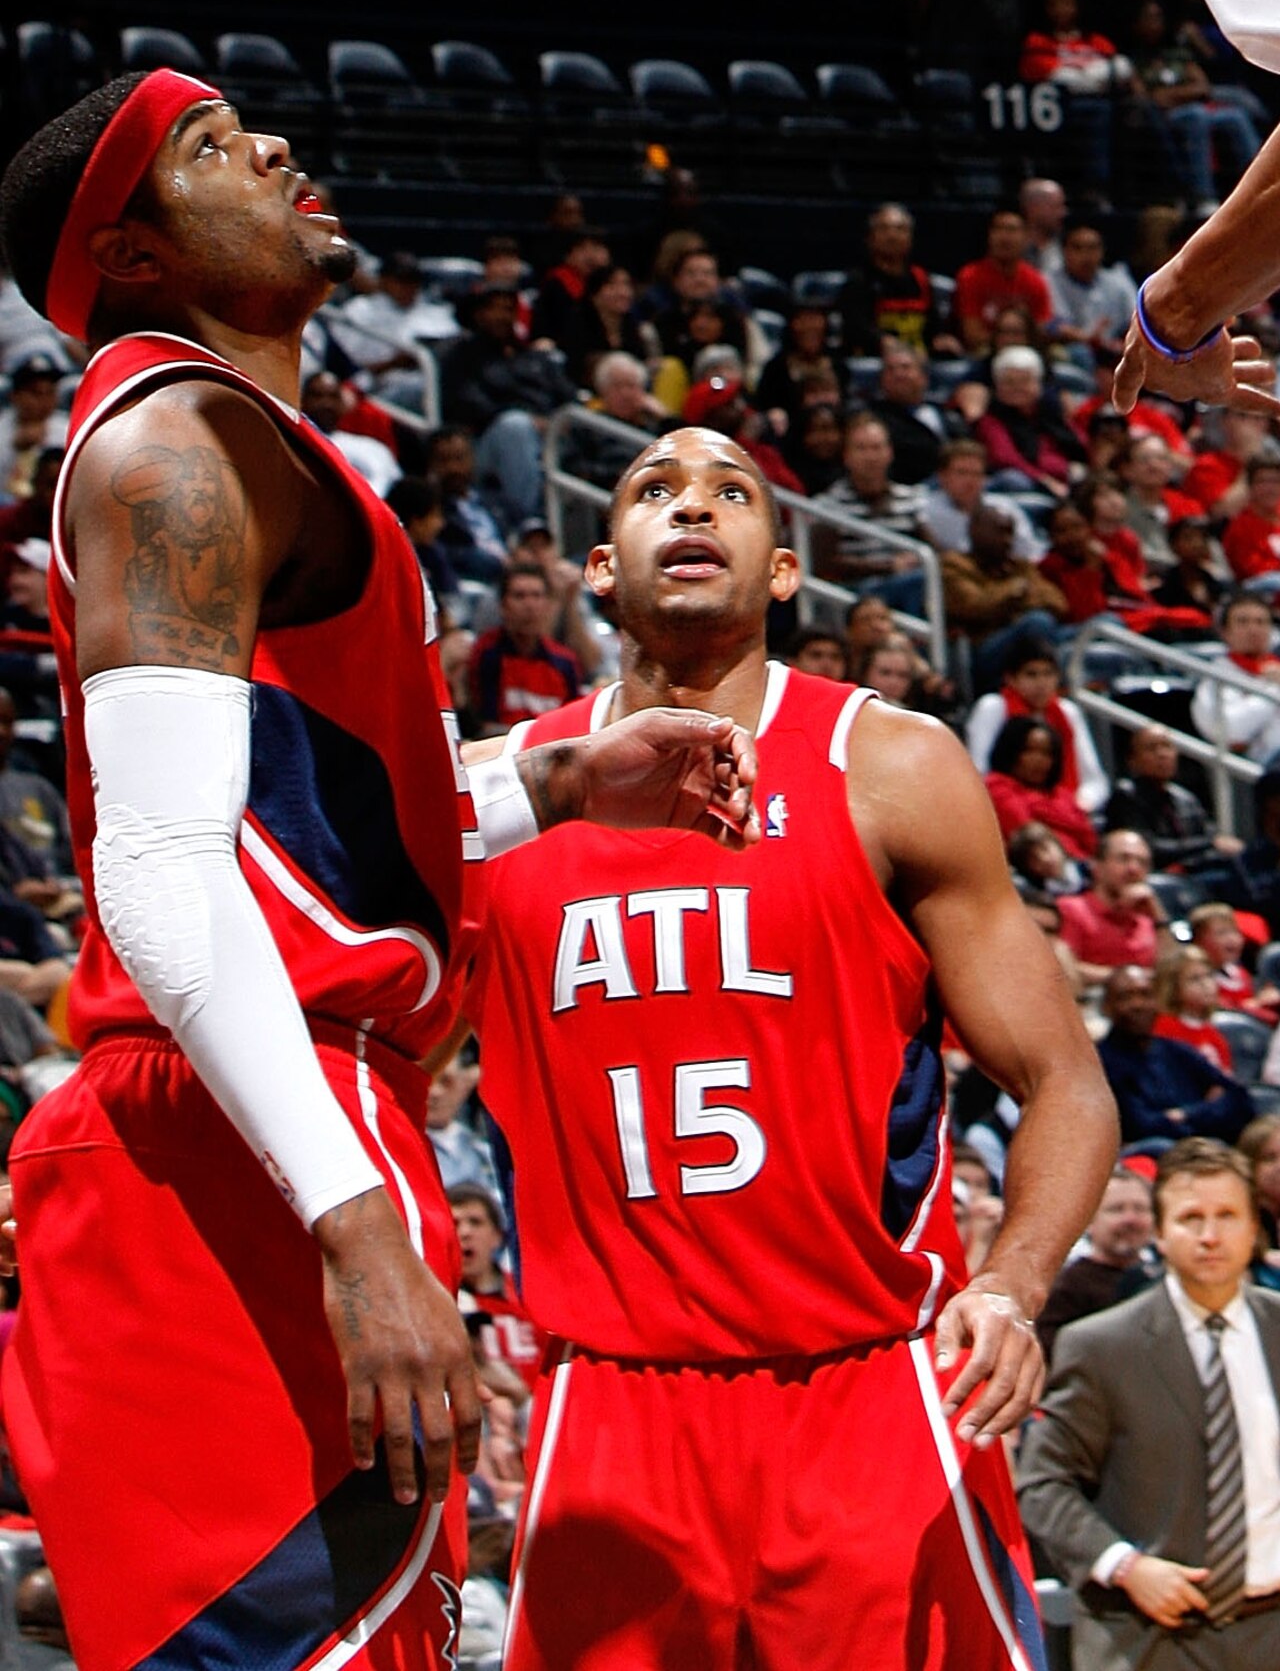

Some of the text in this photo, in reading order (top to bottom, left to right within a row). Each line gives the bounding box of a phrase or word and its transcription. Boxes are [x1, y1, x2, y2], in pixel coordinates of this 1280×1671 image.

[980, 82, 1064, 135] 116
[552, 886, 793, 1015] ATL
[606, 1057, 768, 1201] 15
